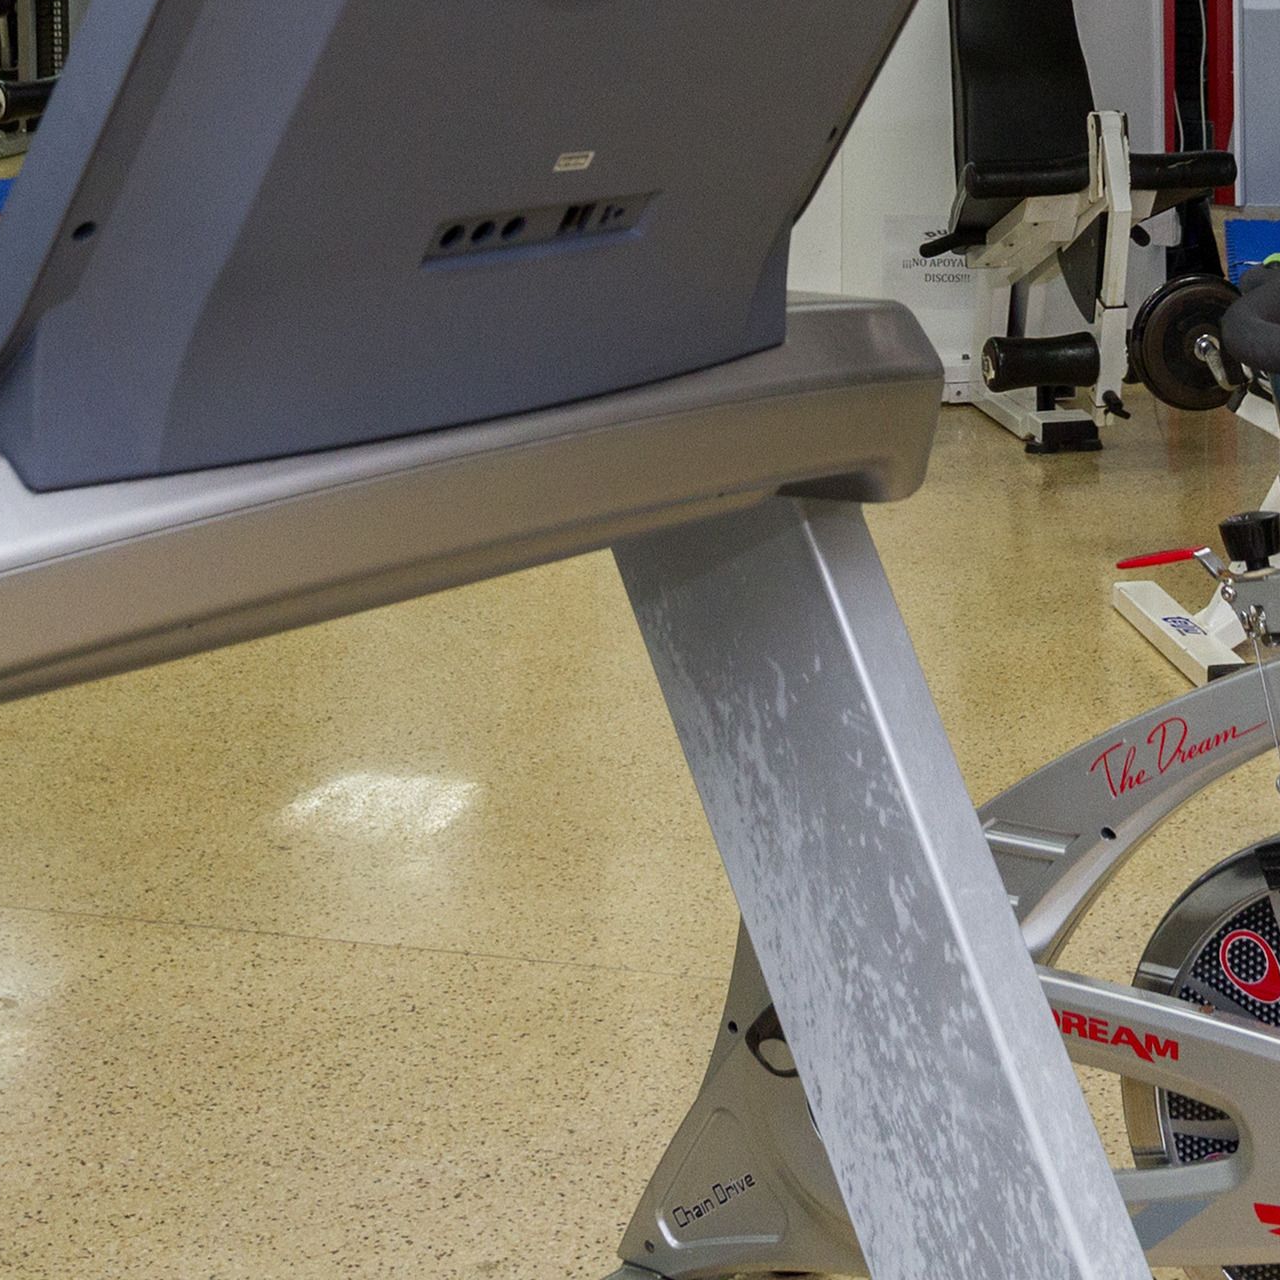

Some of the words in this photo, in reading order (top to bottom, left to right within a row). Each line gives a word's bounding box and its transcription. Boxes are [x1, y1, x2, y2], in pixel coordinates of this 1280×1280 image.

[929, 259, 968, 268] APOYA
[1089, 742, 1152, 798] The
[1147, 716, 1267, 774] Dream
[671, 1197, 716, 1228] Chain
[711, 1173, 756, 1205] Drive
